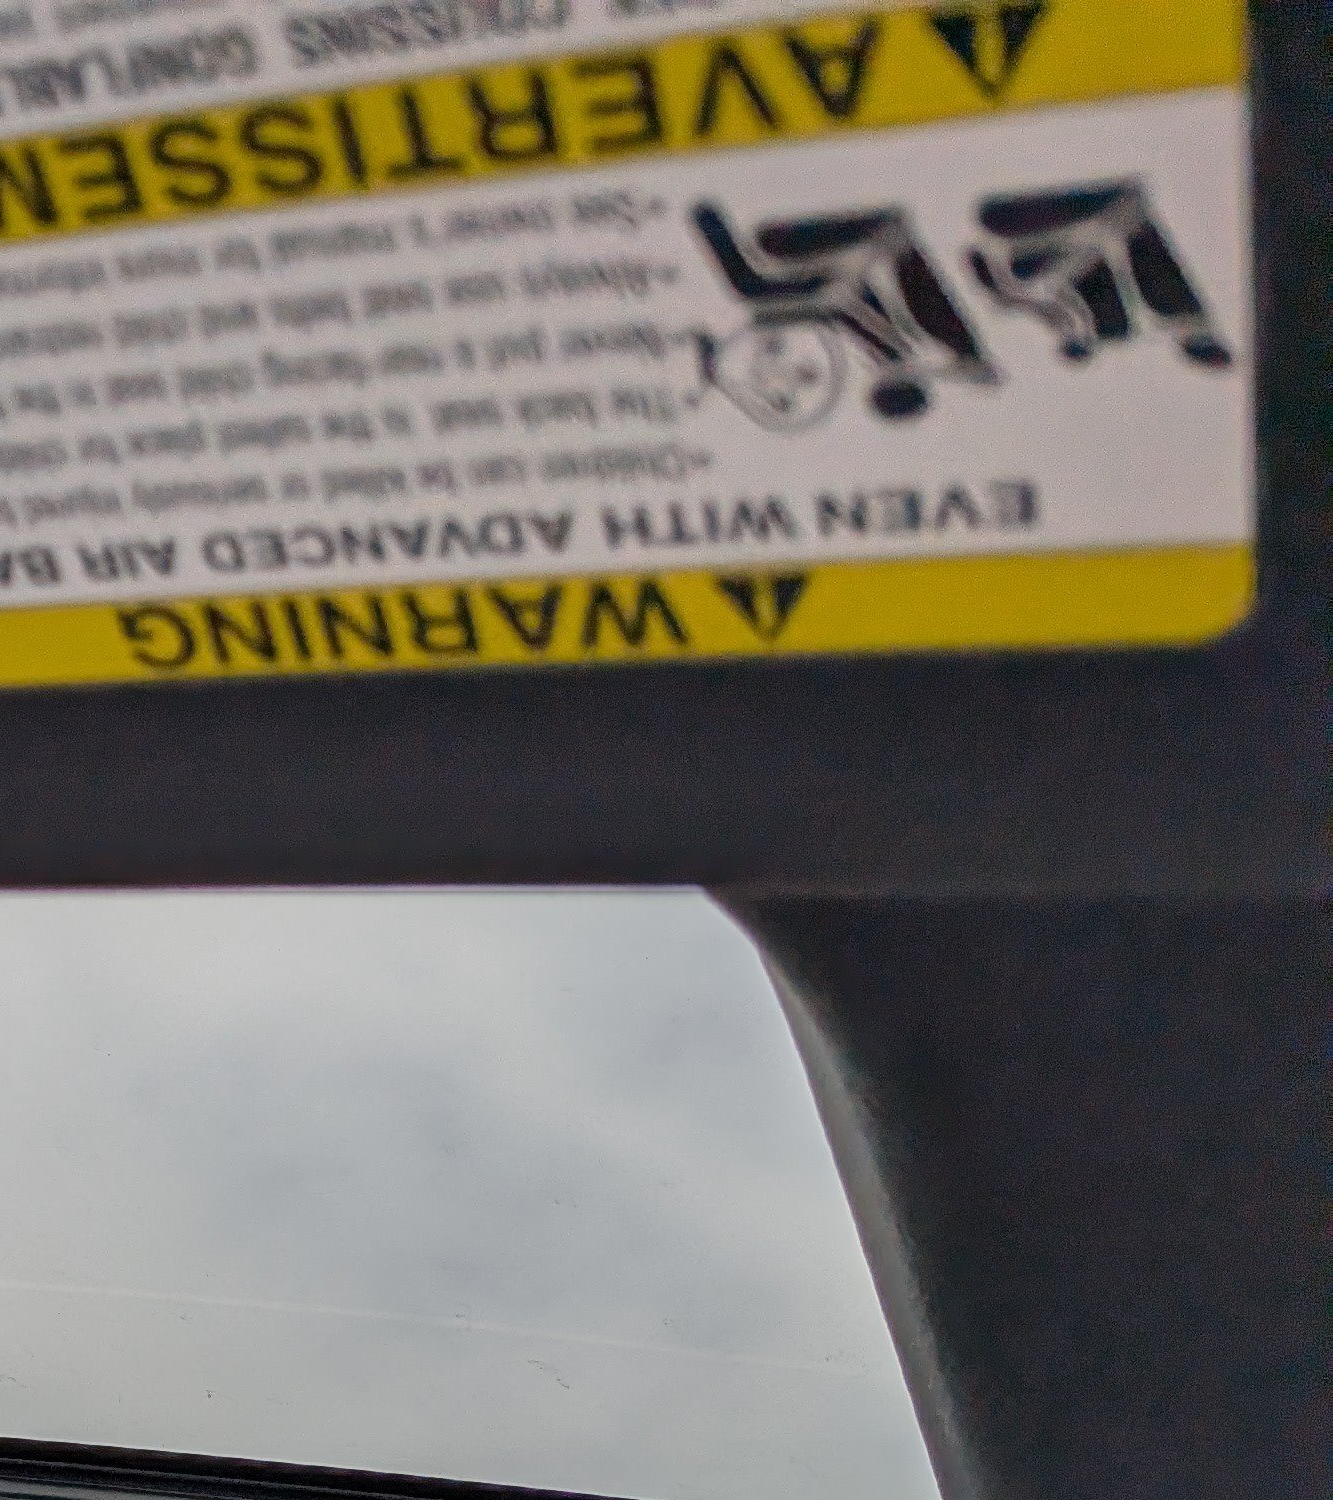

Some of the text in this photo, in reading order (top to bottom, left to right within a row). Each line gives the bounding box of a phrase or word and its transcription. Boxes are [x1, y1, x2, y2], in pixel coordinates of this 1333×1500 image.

[601, 494, 799, 552] WITH
[815, 476, 1041, 542] EVEN
[76, 534, 178, 583] AIR
[199, 512, 575, 578] ADVANCED
[117, 580, 692, 671] WARNING
